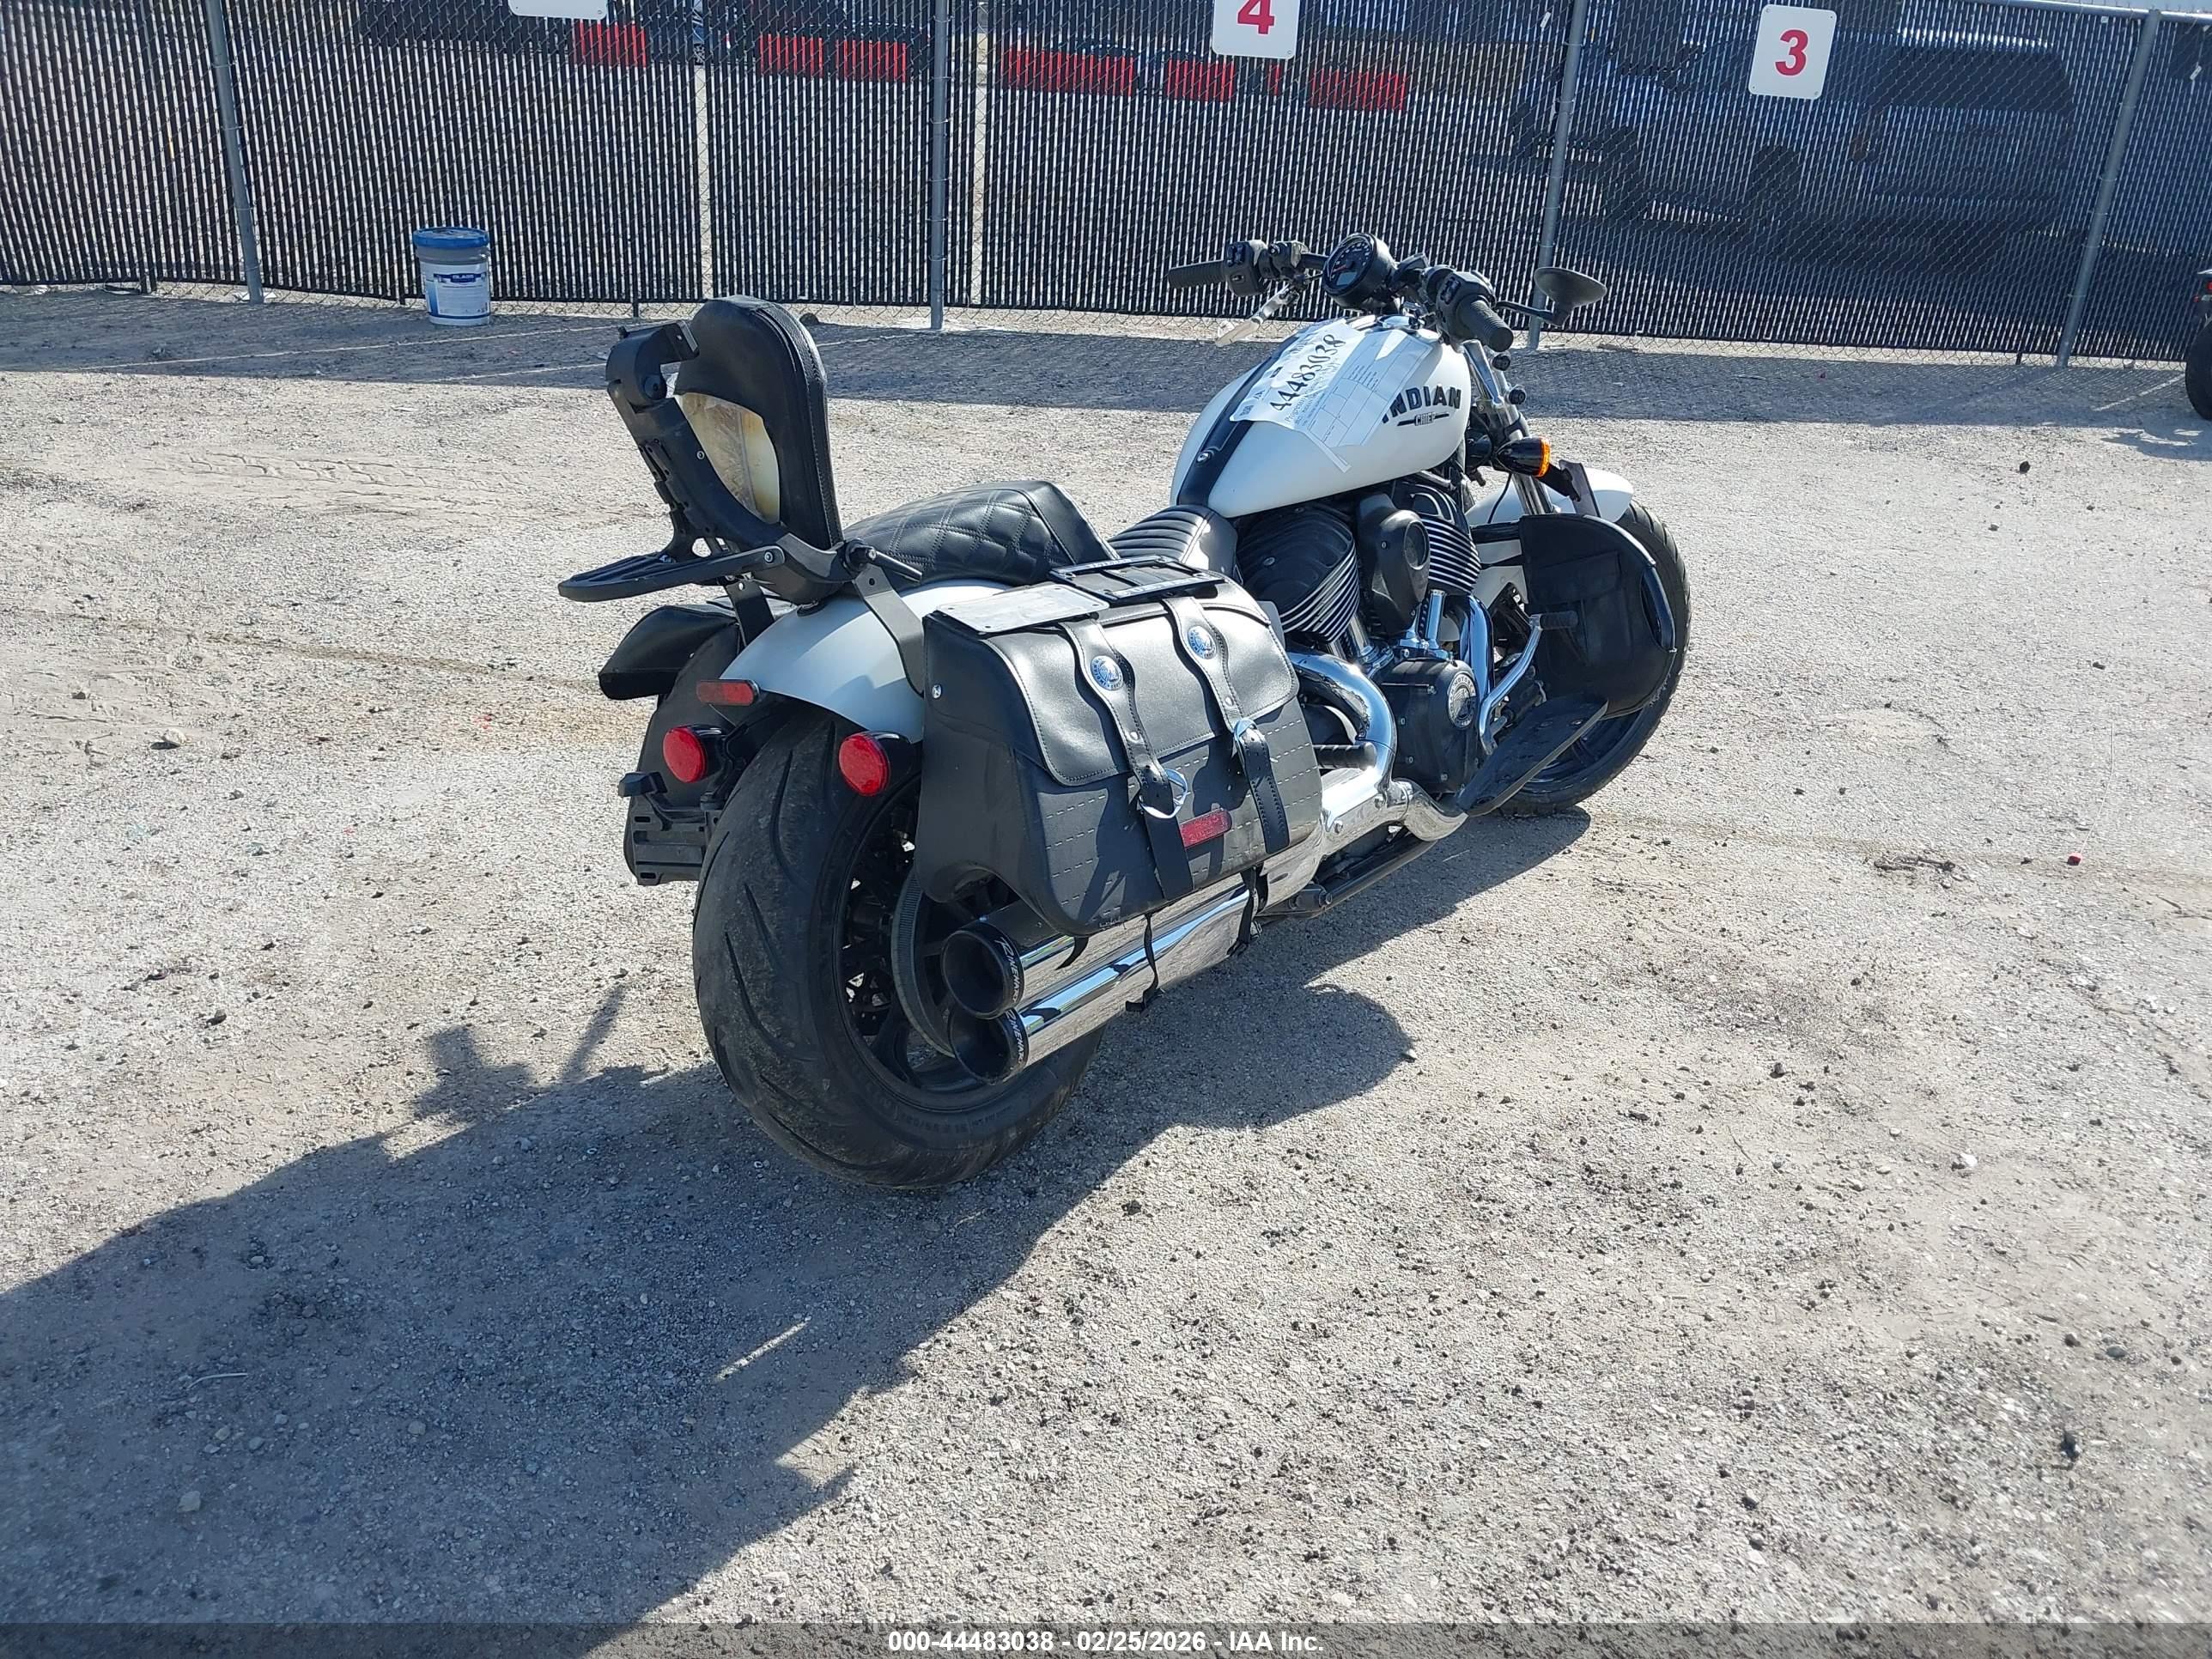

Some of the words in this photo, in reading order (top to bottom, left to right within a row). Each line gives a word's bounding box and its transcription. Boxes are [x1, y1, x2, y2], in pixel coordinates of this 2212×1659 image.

[1237, 0, 1275, 34] 4
[1775, 29, 1808, 76] 3
[1269, 334, 1346, 411] 44483038
[1382, 385, 1462, 423] NDIAN
[1414, 412, 1437, 426] CHIEF
